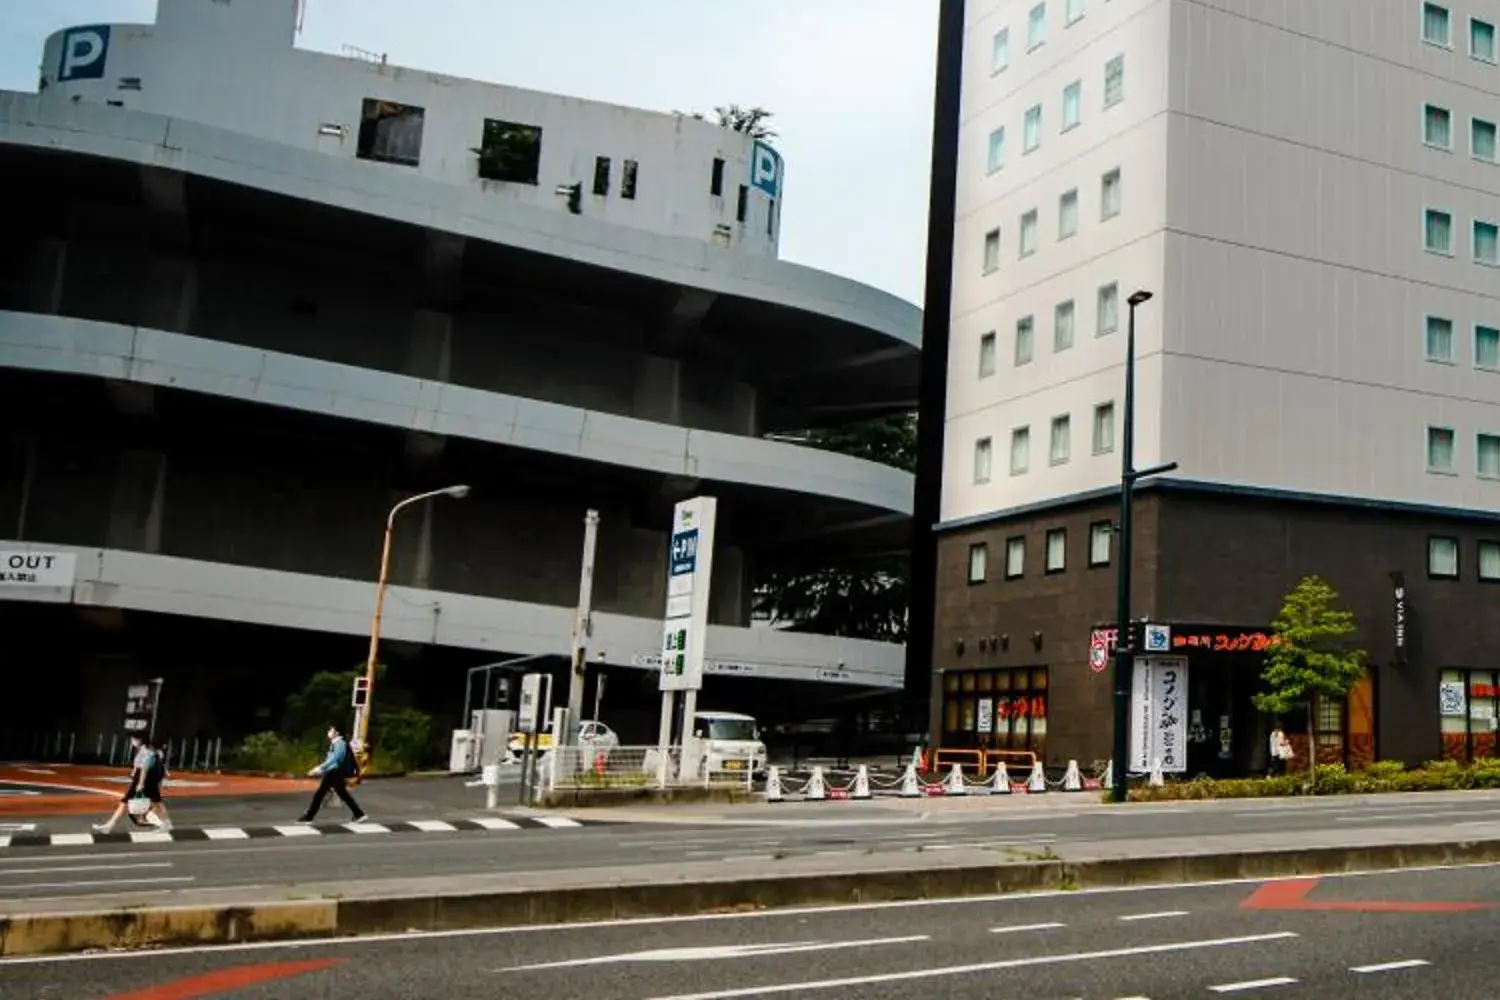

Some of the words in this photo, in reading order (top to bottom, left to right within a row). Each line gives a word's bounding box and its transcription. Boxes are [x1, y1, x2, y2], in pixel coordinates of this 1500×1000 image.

[62, 31, 103, 77] P
[754, 147, 777, 184] P
[8, 555, 56, 569] OUT
